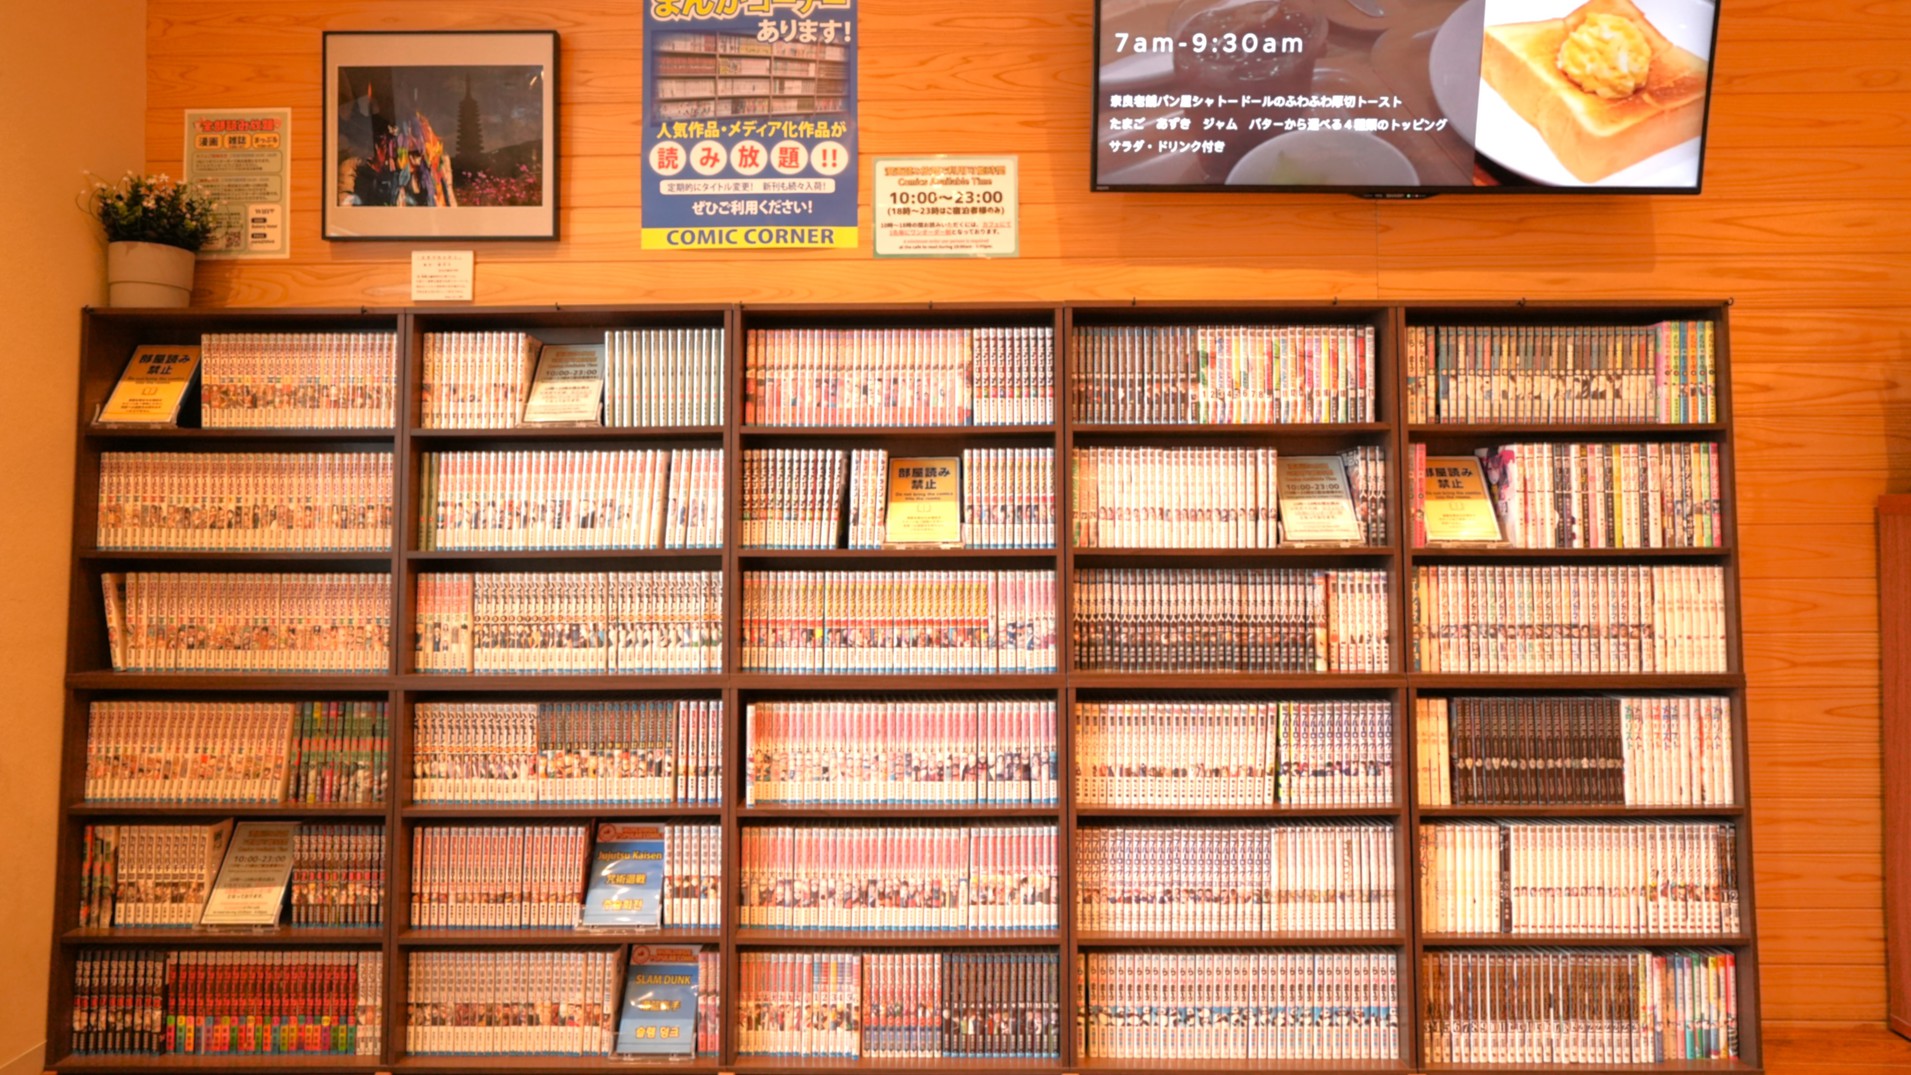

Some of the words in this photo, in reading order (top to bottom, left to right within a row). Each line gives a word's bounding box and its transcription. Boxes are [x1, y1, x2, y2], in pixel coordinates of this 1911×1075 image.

[657, 121, 847, 139] 人気作品・メディア化作品が
[1109, 117, 1146, 130] たまご
[1155, 117, 1192, 130] あずき
[1202, 118, 1239, 130] ジャム
[692, 200, 813, 215] ぜひご利用ください!
[667, 229, 738, 246] COMIC
[744, 228, 834, 245] CORNER
[911, 479, 937, 490] 禁止
[635, 974, 662, 985] SLAM
[664, 974, 691, 985] DUNK
